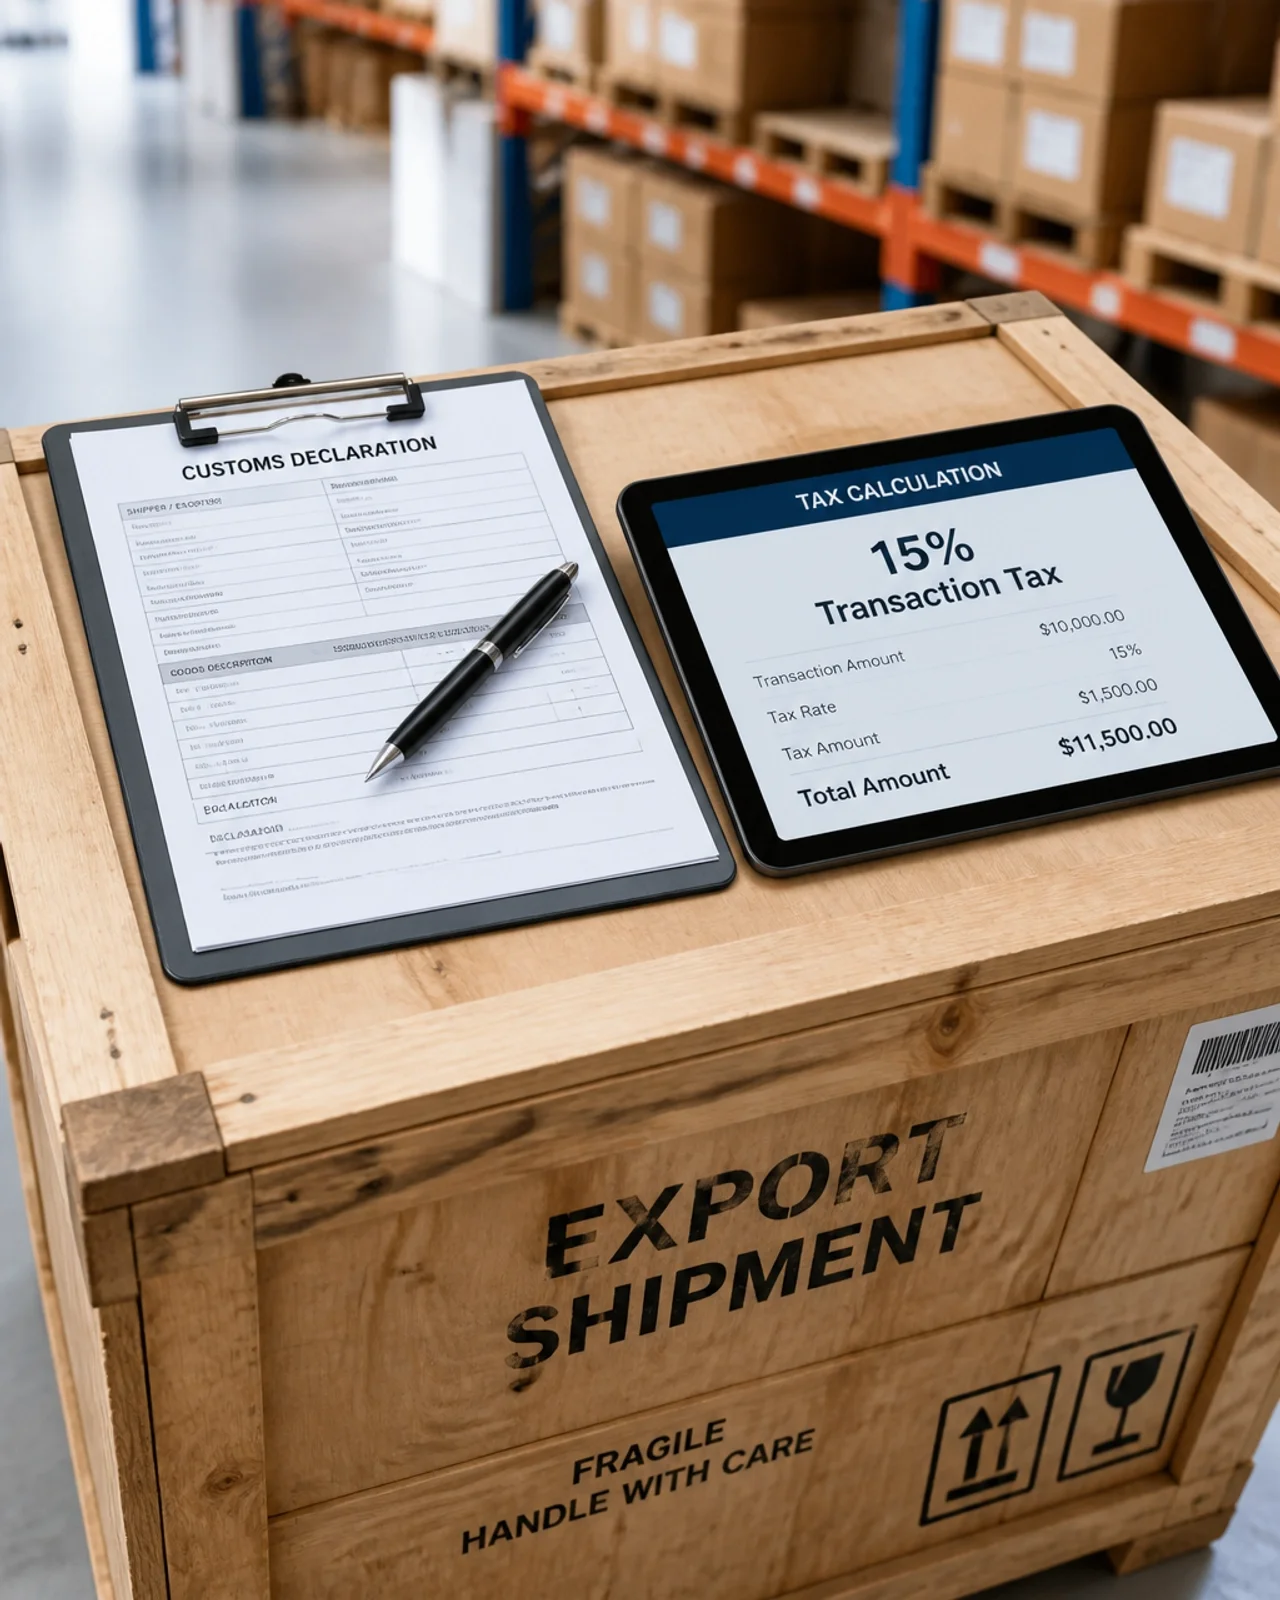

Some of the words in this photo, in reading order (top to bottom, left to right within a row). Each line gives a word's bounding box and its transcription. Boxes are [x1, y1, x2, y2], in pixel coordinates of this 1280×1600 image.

[182, 454, 285, 481] CUSTOMS
[290, 435, 437, 467] DECLARATION
[794, 488, 844, 510] TAX
[847, 461, 1003, 502] CALCULATION
[871, 527, 975, 575] 15%
[814, 577, 1002, 625] Transaction
[1002, 566, 1063, 591] Tax
[1039, 609, 1125, 637] $10,000.00
[752, 664, 843, 688] Transaction
[847, 651, 906, 672] Amount
[1109, 643, 1143, 660] 15%
[766, 710, 798, 724] Tax
[799, 703, 837, 719] Rate
[1078, 678, 1158, 705] $1,500.00
[781, 747, 813, 761] Tax
[817, 732, 881, 755] Amount
[1058, 717, 1178, 757] $11,500.00
[796, 780, 857, 807] Total
[863, 763, 951, 796] Amount
[545, 1112, 967, 1279] EXPORT
[505, 1191, 983, 1370] SHIPMENT
[572, 1418, 727, 1485] FRAGILE
[462, 1489, 609, 1555] HANDLE
[622, 1459, 710, 1505] WITH
[722, 1428, 815, 1475] CARE
